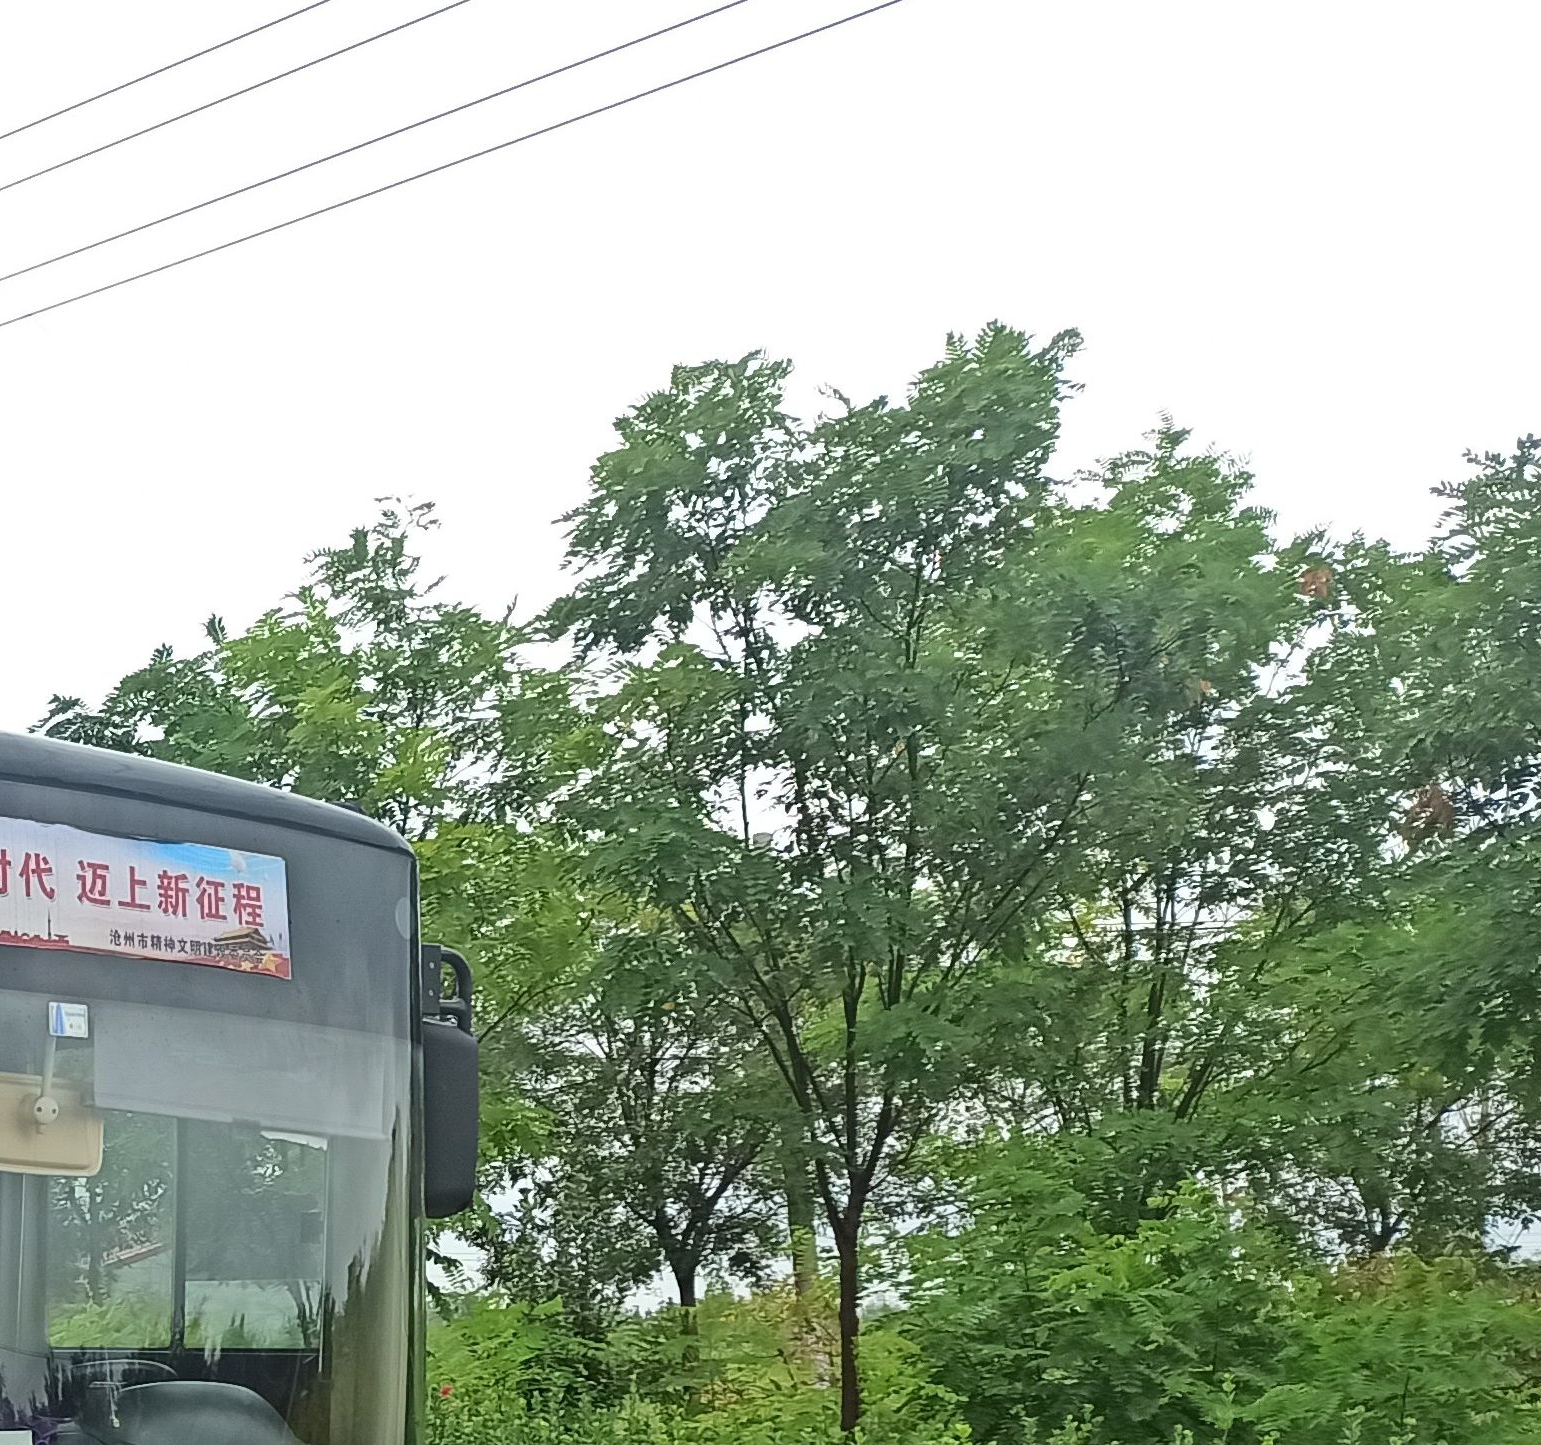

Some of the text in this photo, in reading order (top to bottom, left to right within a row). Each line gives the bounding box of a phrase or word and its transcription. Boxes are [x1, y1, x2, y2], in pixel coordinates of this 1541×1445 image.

[76, 859, 265, 929] 迈上新征程
